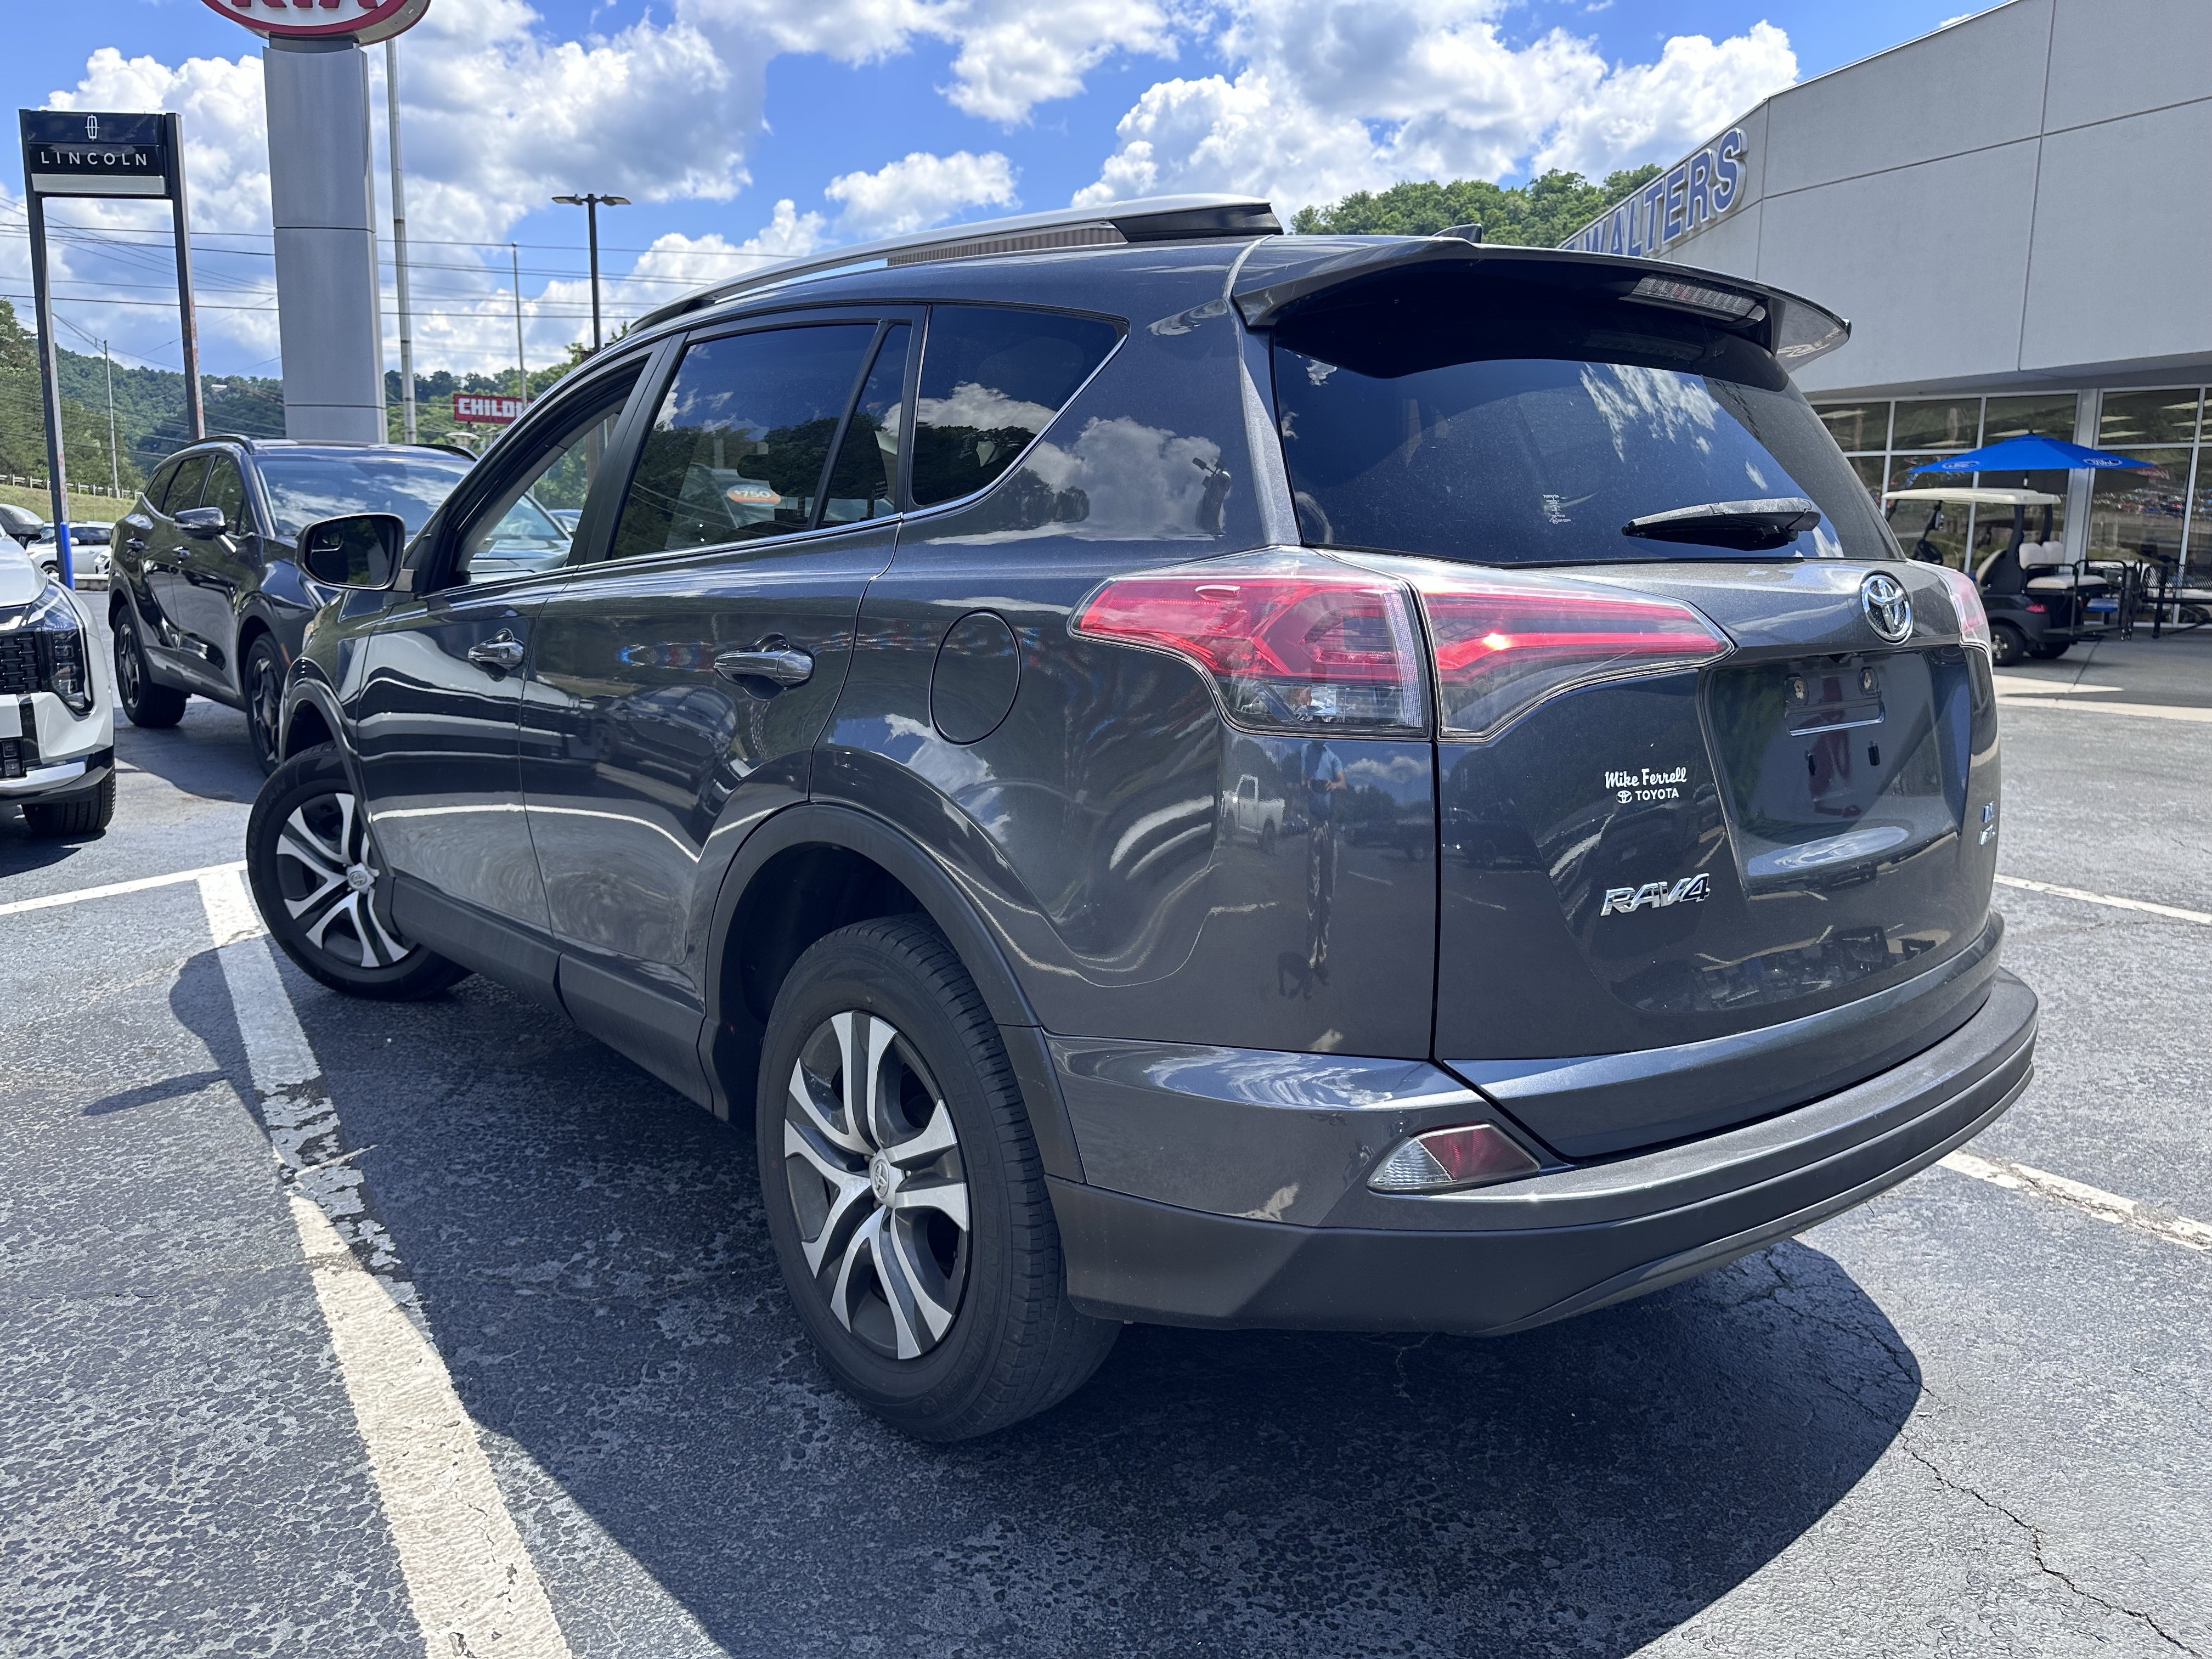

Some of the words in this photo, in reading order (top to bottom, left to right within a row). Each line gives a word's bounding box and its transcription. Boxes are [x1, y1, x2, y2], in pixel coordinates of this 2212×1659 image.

[41, 151, 147, 166] LINCOLN
[1605, 771, 1639, 789] Mike
[1641, 767, 1687, 786] Ferrell
[1635, 788, 1679, 801] TOYOTA
[1599, 873, 1710, 917] RAV4
[950, 1072, 999, 1367] GEOLANDAR
